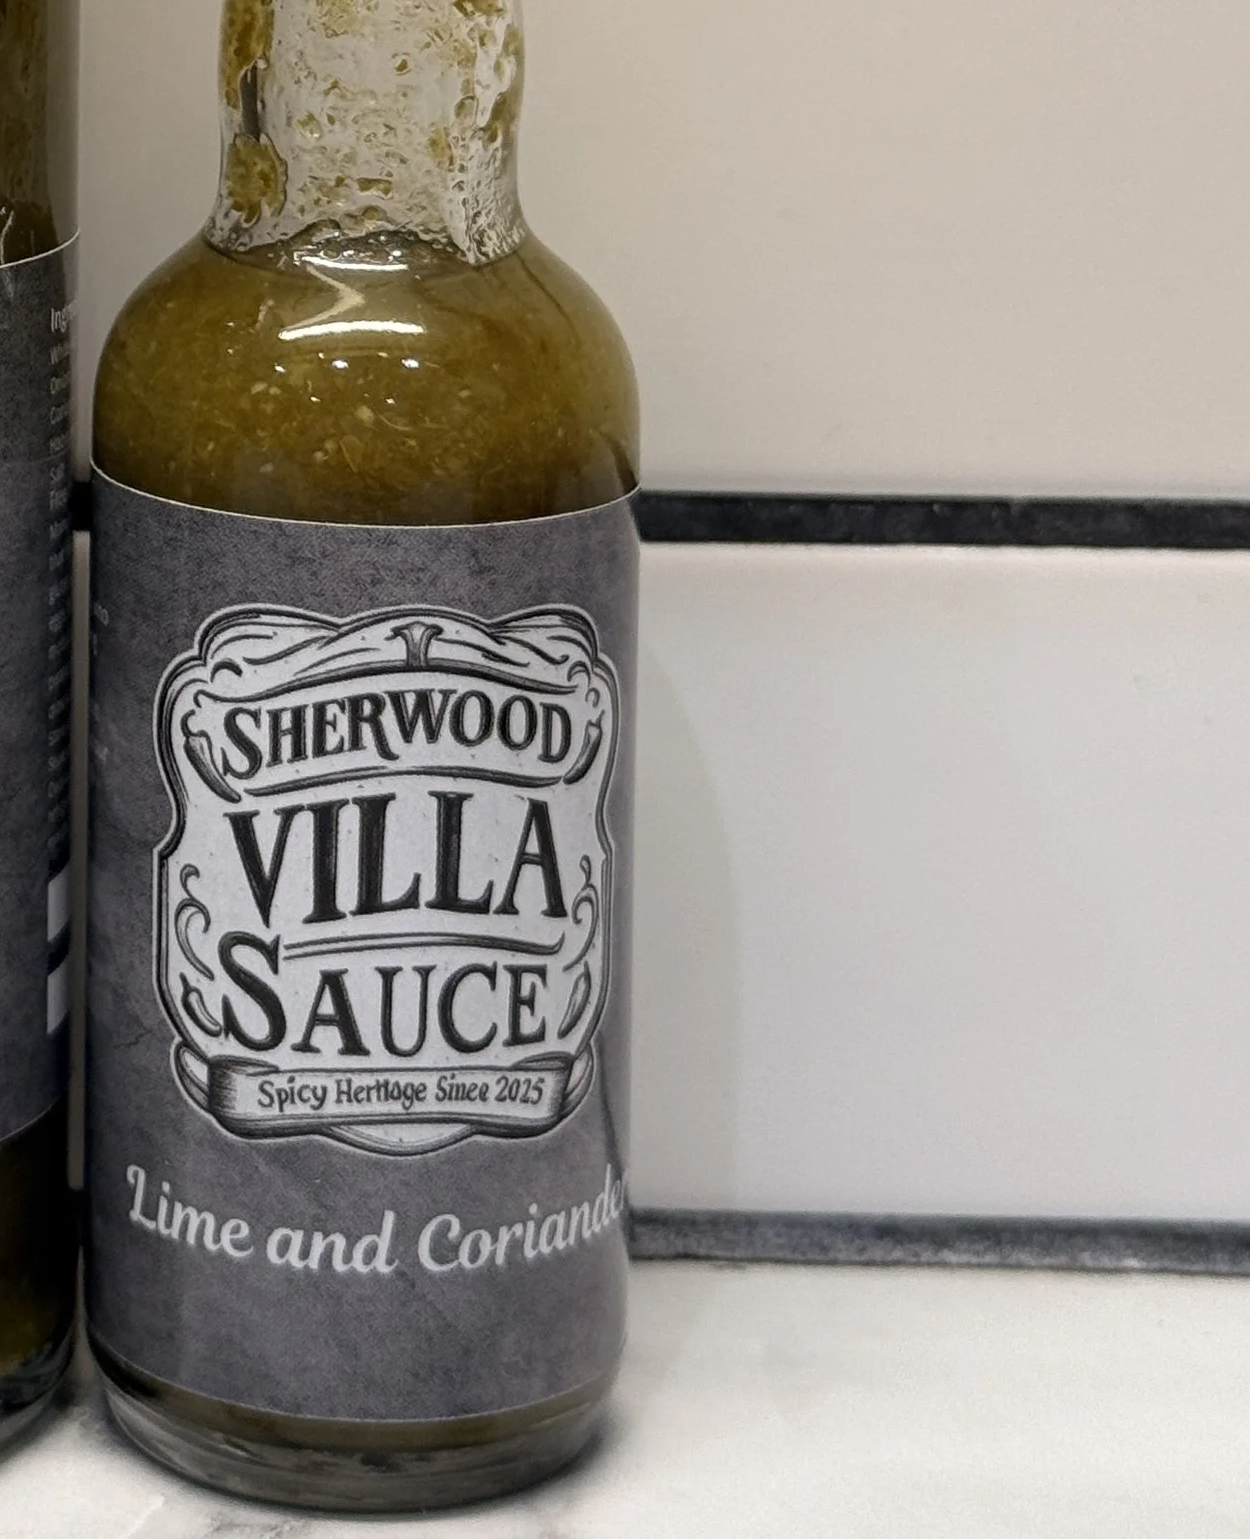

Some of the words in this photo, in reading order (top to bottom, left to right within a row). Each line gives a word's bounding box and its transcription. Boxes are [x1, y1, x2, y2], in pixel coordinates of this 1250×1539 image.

[221, 688, 572, 780] SHERWOOD
[223, 791, 568, 928] VILLA
[217, 931, 548, 1058] SAUCE
[257, 1075, 327, 1112] Spicy
[494, 1076, 545, 1105] 2025
[126, 1164, 251, 1258] Lime
[266, 1210, 399, 1274] and
